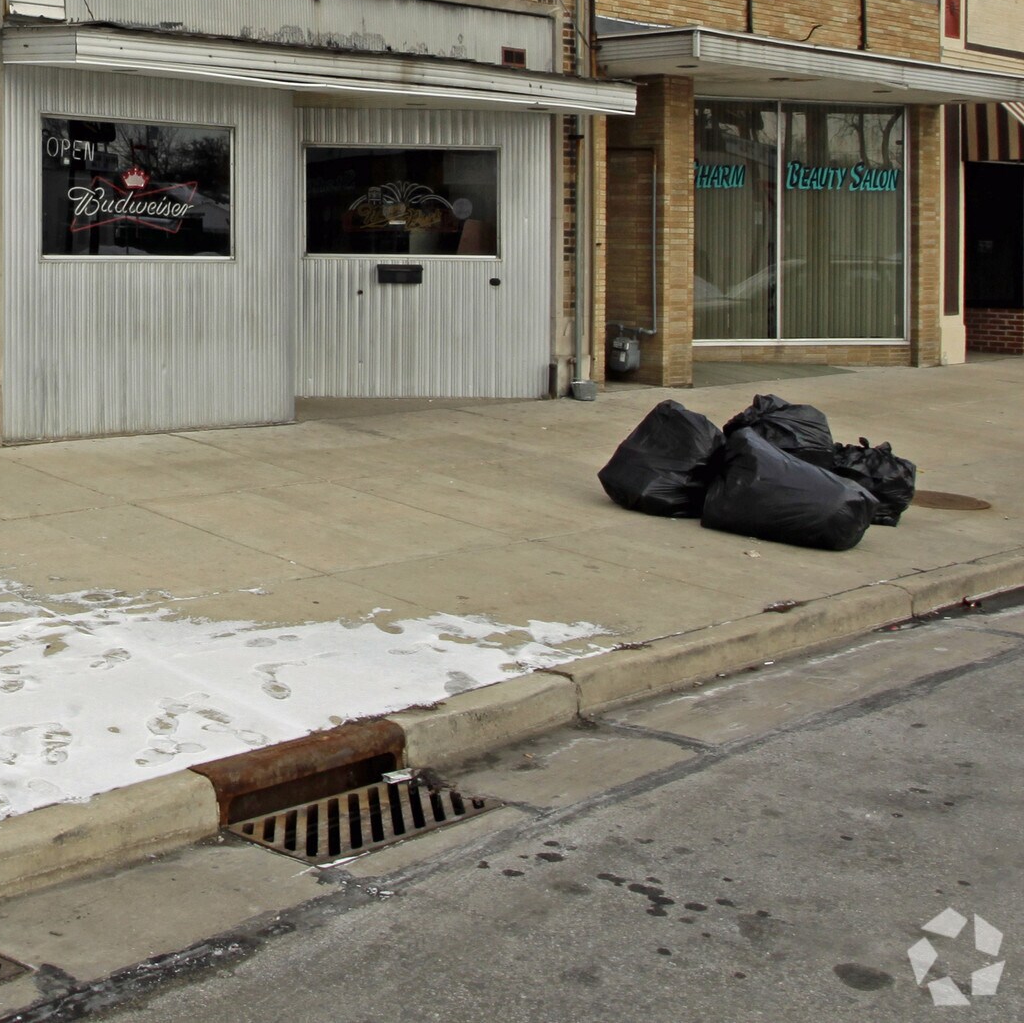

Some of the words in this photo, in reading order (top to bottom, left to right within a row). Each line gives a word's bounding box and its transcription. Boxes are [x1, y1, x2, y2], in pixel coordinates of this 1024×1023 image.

[46, 137, 95, 161] OPEN
[786, 160, 847, 191] BEAUTY
[848, 161, 900, 192] SALON
[67, 187, 194, 217] Budweiser
